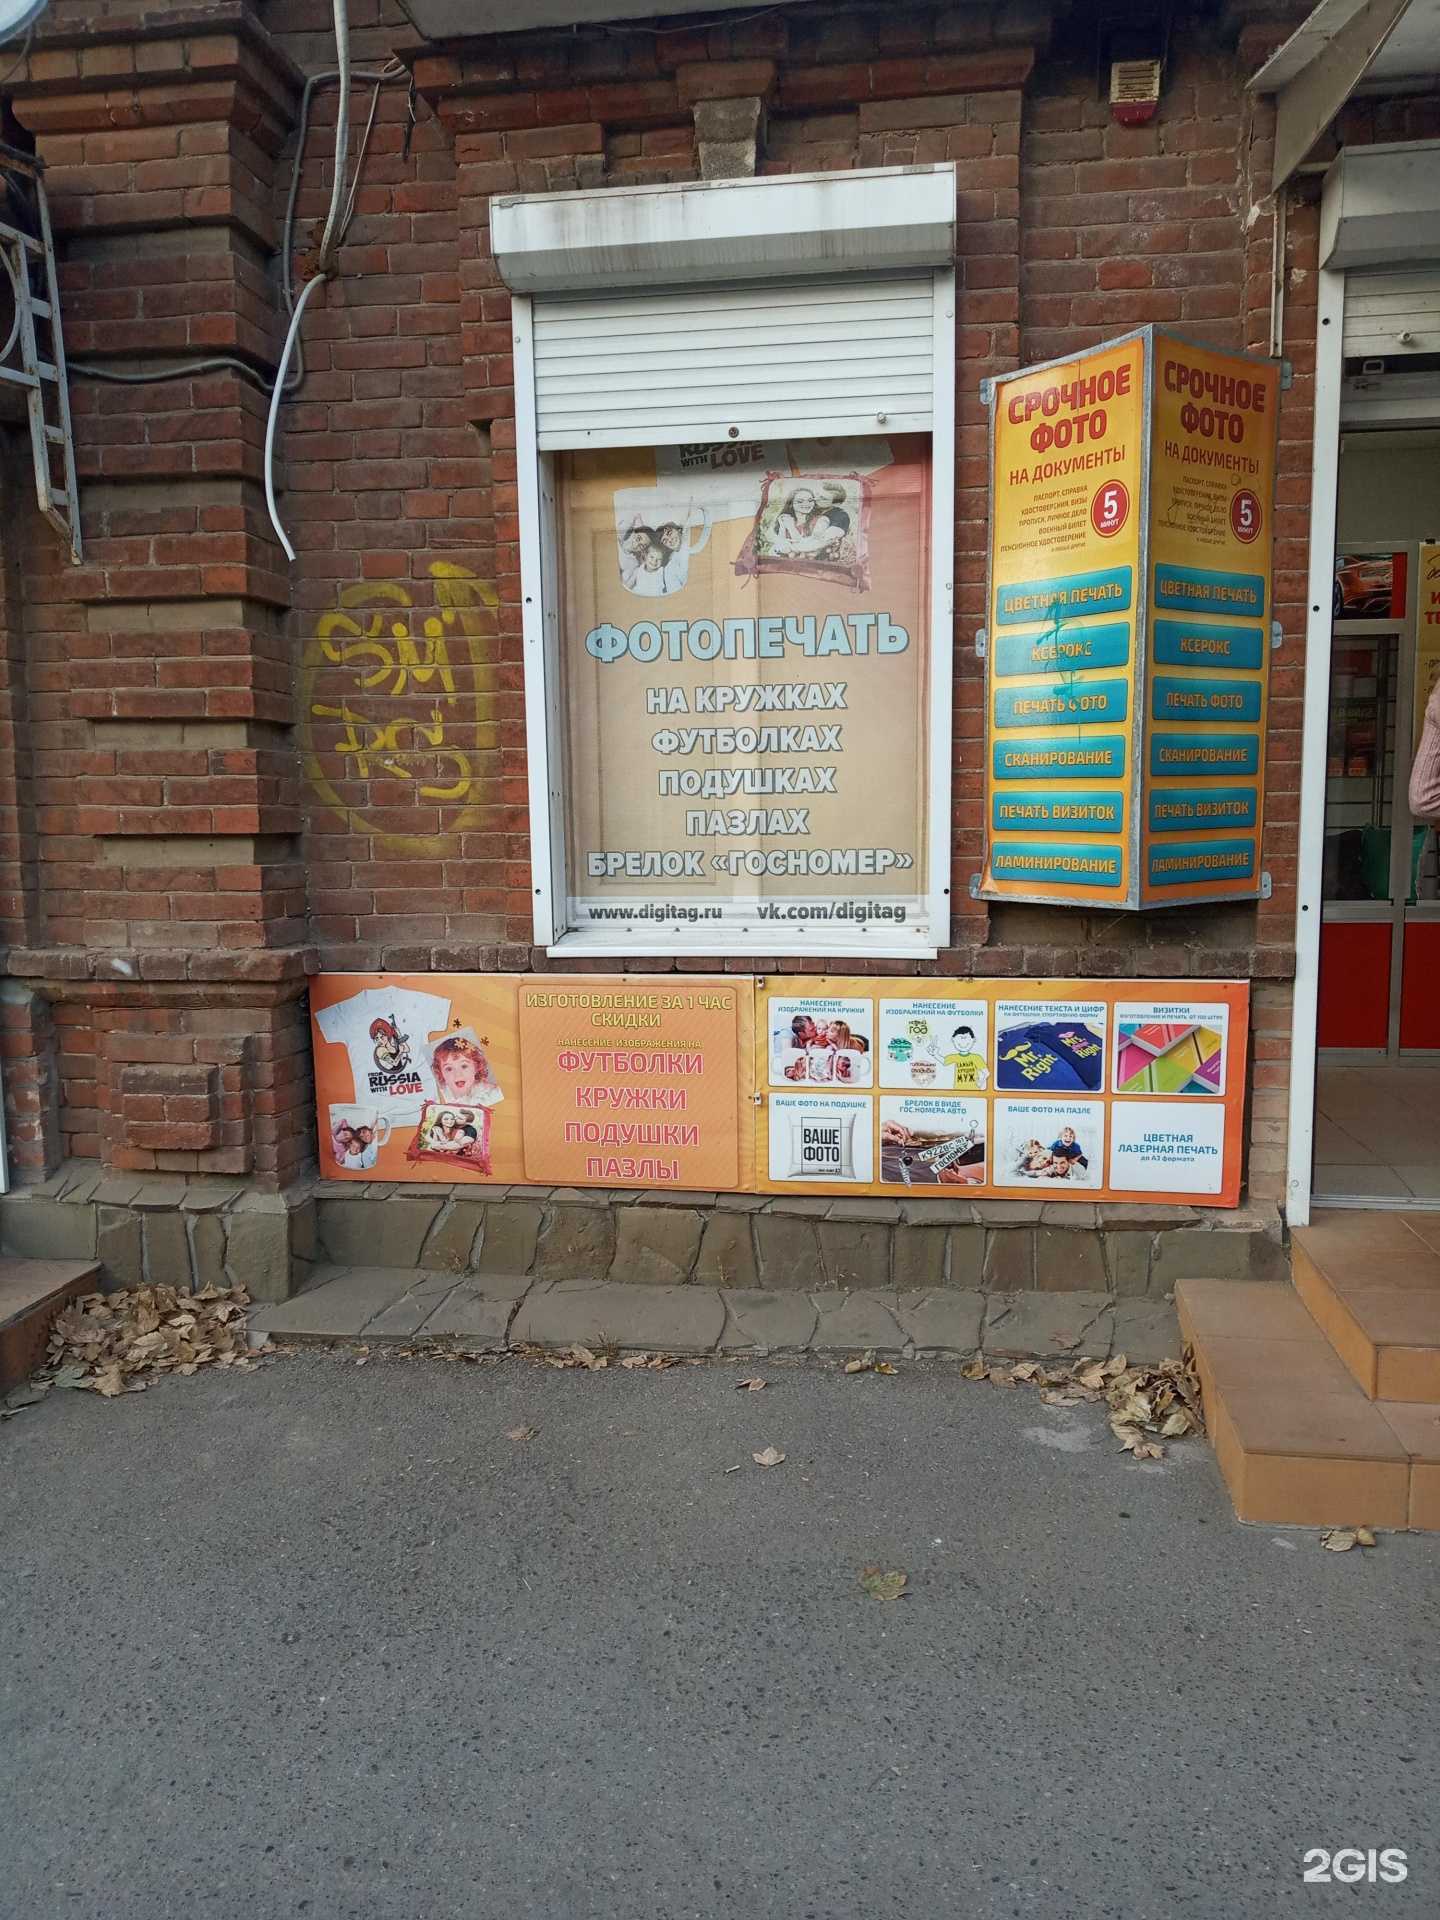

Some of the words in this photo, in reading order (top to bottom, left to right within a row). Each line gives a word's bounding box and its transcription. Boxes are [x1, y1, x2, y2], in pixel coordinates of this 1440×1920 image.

[1008, 363, 1131, 425] СРОЧНОЕ
[1164, 360, 1266, 413] СРОЧНОЕ
[1030, 409, 1108, 453] ФОТО
[1180, 402, 1244, 443] ФОТО
[711, 442, 765, 469] LOVE
[1164, 440, 1180, 459] НА
[1182, 445, 1259, 475] ДОКУМЕНТЫ
[1009, 470, 1030, 486] НА
[1032, 445, 1125, 483] ДОКУМЕНТЫ
[1103, 490, 1118, 519] 5
[1240, 499, 1253, 526] 5
[1004, 591, 1067, 614] ЦВЕТНАЯ
[1071, 584, 1123, 603] ПЕЧАТЬ
[1161, 580, 1210, 599] ЦВЕТНАЯ
[1215, 586, 1257, 604] ПЕЧАТЬ
[585, 612, 910, 664] ФОТОПЕЧАТЬ
[1180, 638, 1231, 655] КСЕРОКС
[1031, 641, 1093, 661] КСЕРОКС
[646, 687, 690, 714] НА
[694, 682, 848, 713] КРУЖКАХ
[1013, 698, 1065, 715] ПЕЧАТЬ
[1167, 693, 1207, 708] ПЕЧАТЬ
[1210, 694, 1243, 709] ФОТО
[651, 725, 842, 755] ФУТБОЛКАХ
[1005, 751, 1113, 767] СКАНИРОВАНИЕ
[1160, 748, 1248, 763] СКАНИРОВАНИЕ
[658, 766, 837, 799] ПОДУШКАХ
[999, 805, 1049, 819] ПЕЧАТЬ
[1052, 805, 1115, 820] ВИЗИТОК
[1155, 804, 1194, 818] ПЕЧАТЬ
[1196, 802, 1249, 817] ВИЗИТОК
[685, 808, 810, 836] ПАЗЛАХ
[587, 850, 704, 877] БРЕЛОК
[711, 848, 913, 876] «ГОСНОМЕР»
[995, 855, 1116, 874] ЛАМИНИРОВАНИЕ
[1152, 853, 1249, 873] ЛАМИНИРОВАНИЕ
[588, 904, 722, 922] www.digitag.ru
[757, 901, 906, 923] vk.com/digitag
[526, 993, 658, 1009] ИЗГОТОВЛЕНИЕ
[661, 995, 683, 1010] ЗА
[687, 996, 694, 1010] 1
[698, 996, 734, 1011] ЧАС
[998, 1004, 1044, 1012] НАНЕСЕНИЕ
[1081, 1005, 1105, 1013] ЦИФР
[1153, 1006, 1190, 1014] ВИЗИТКИ
[591, 1013, 662, 1029] СКИДКИ
[558, 1039, 613, 1048] НАНЕСЕНИЕ
[616, 1039, 687, 1049] ИЗОБРАЖЕНИЯ
[688, 1041, 702, 1049] НА
[558, 1051, 704, 1075] ФУТБОЛКИ
[369, 1072, 421, 1087] RUSSIA
[389, 1083, 424, 1096] LOVE
[575, 1086, 688, 1111] КРУЖКИ
[775, 1099, 797, 1107] ВАШЕ
[831, 1101, 867, 1109] ПОДУШКЕ
[947, 1107, 967, 1115] АВТО
[1007, 1105, 1030, 1113] ВАШЕ
[1031, 1105, 1053, 1114] ФОТО
[1054, 1106, 1065, 1114] НА
[1066, 1106, 1091, 1115] ПАЗЛЕ
[564, 1121, 700, 1148] ПОДУШКИ
[803, 1128, 840, 1145] ВАШЕ
[1143, 1133, 1194, 1144] ЦВЕТНАЯ
[803, 1145, 840, 1162] ФОТО
[1118, 1144, 1174, 1154] ЛАЗЕРНАЯ
[1176, 1145, 1218, 1155] ПЕЧАТЬ
[1161, 1155, 1195, 1163] формата
[585, 1158, 680, 1181] ПАЗЛЫ
